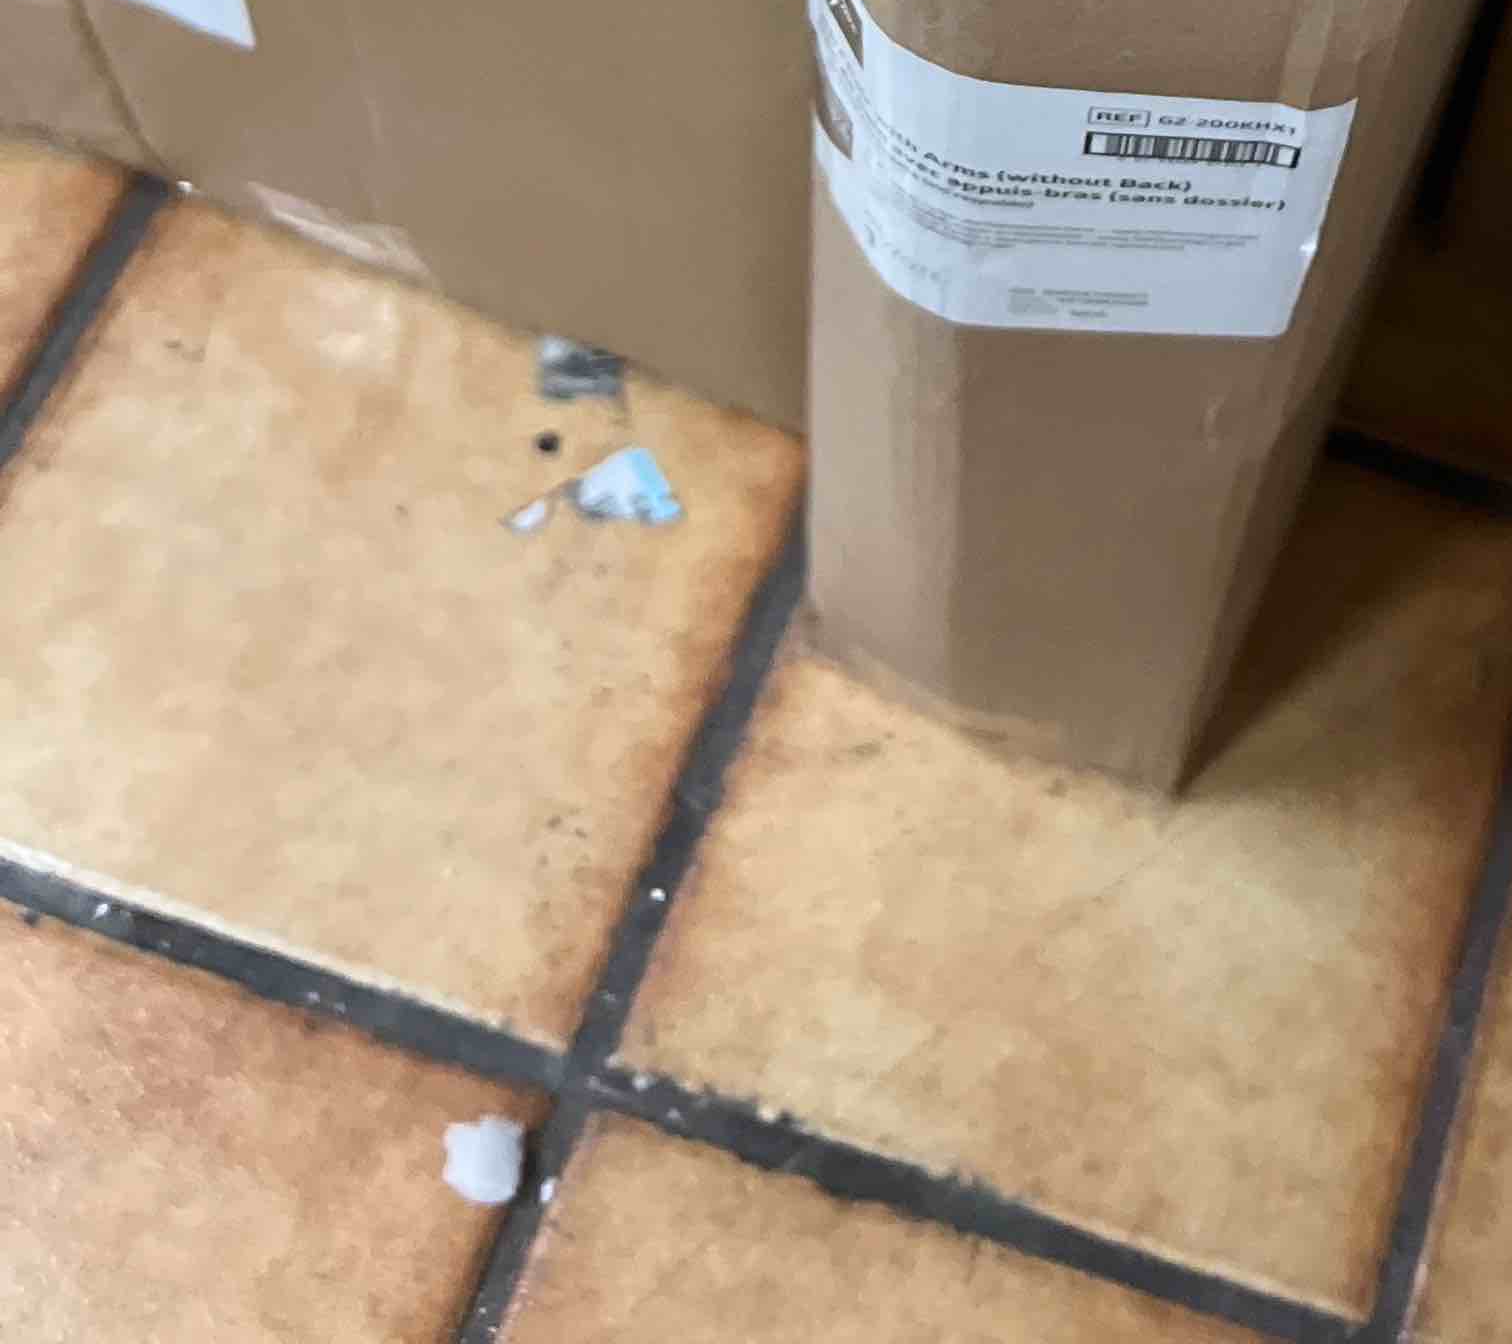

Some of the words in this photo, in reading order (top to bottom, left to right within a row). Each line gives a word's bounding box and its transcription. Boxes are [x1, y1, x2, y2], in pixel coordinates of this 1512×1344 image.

[1096, 111, 1143, 125] REF
[923, 151, 990, 179] Arms
[996, 169, 1112, 188] (without
[1119, 177, 1192, 193] Back)
[1109, 188, 1176, 205] (sans
[1183, 193, 1286, 212] dossier)
